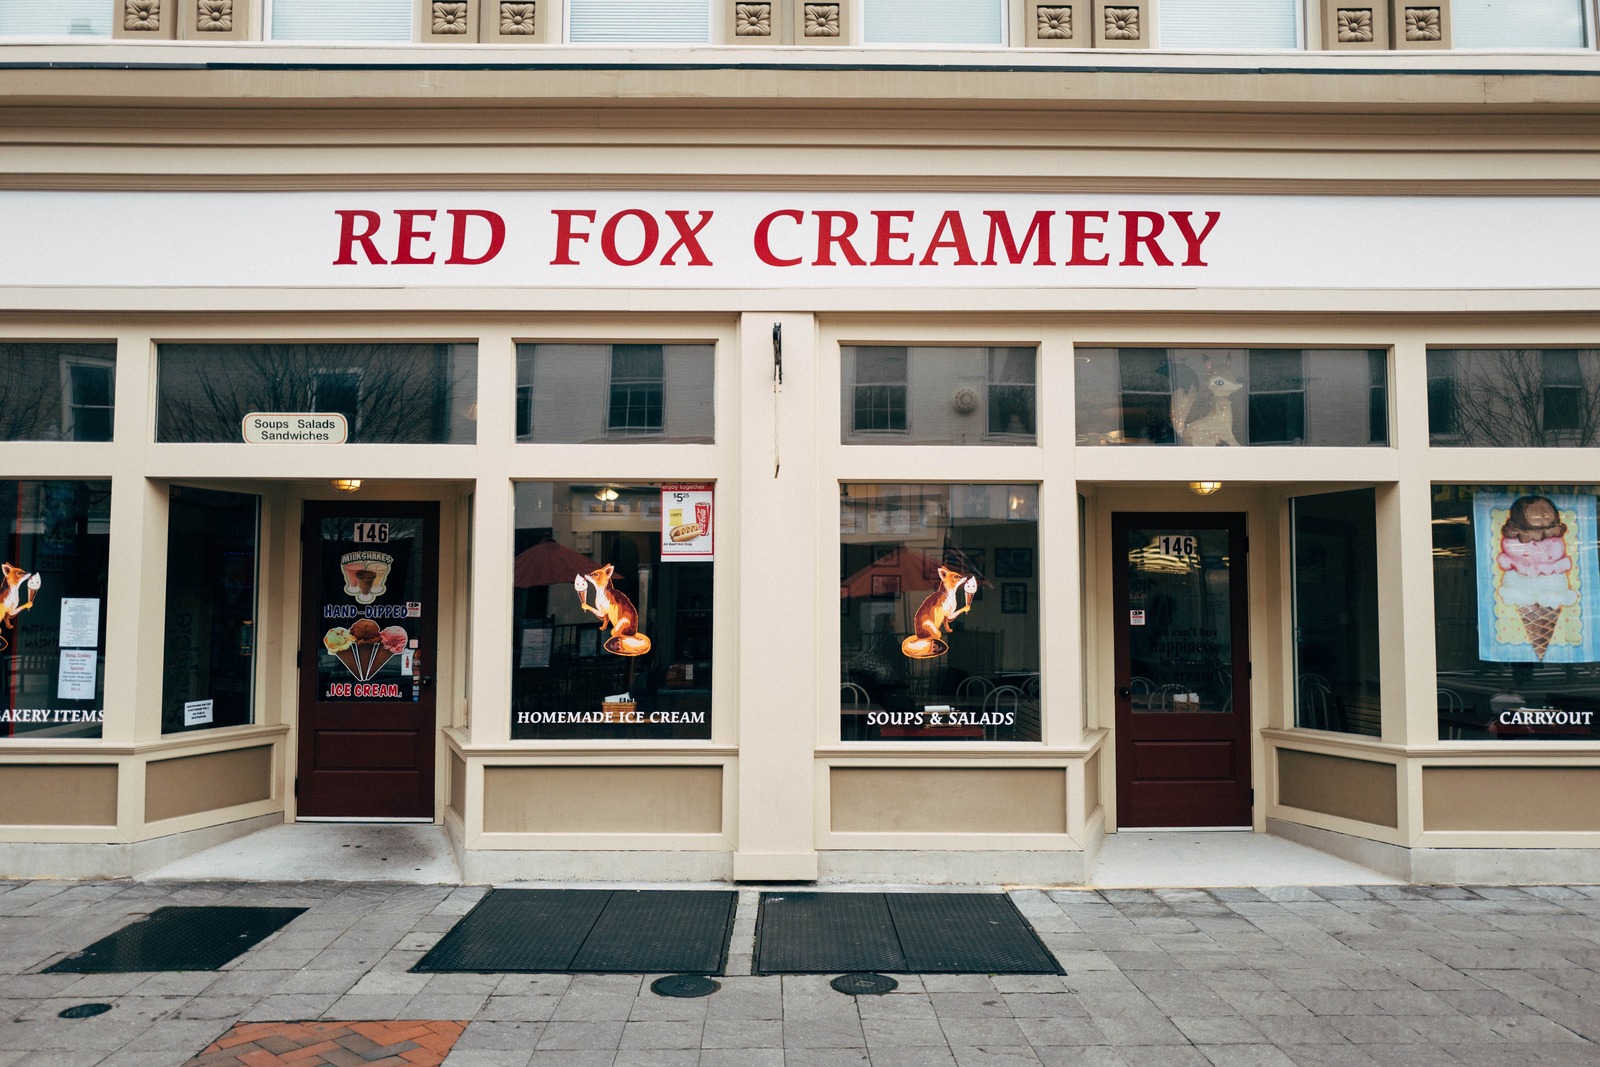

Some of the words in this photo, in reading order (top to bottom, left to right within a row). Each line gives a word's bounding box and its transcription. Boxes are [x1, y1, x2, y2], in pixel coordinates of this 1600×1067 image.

[333, 209, 506, 265] RED
[549, 208, 714, 266] FOX
[753, 208, 1221, 267] CREAMERY
[254, 419, 289, 430] Soups
[297, 419, 336, 429] Salads
[261, 430, 329, 440] Sandwiches
[356, 524, 388, 542] 146
[1162, 537, 1194, 555] 146
[341, 551, 393, 564] MILKSHAKES
[324, 604, 408, 618] HAND-DIPPED
[1172, 627, 1197, 638] can't
[1200, 627, 1219, 640] buy
[331, 683, 351, 697] ICE
[354, 683, 399, 697] CREAM
[0, 709, 51, 722] AKERY
[54, 709, 104, 722] ITEMS
[517, 711, 614, 724] HOMEMADE
[618, 711, 645, 723] ICE
[650, 711, 705, 724] CREAM
[867, 712, 924, 725] SOUPS
[929, 712, 942, 725] &
[948, 712, 1014, 725] SALADS
[1499, 711, 1594, 725] CARRYOUT
